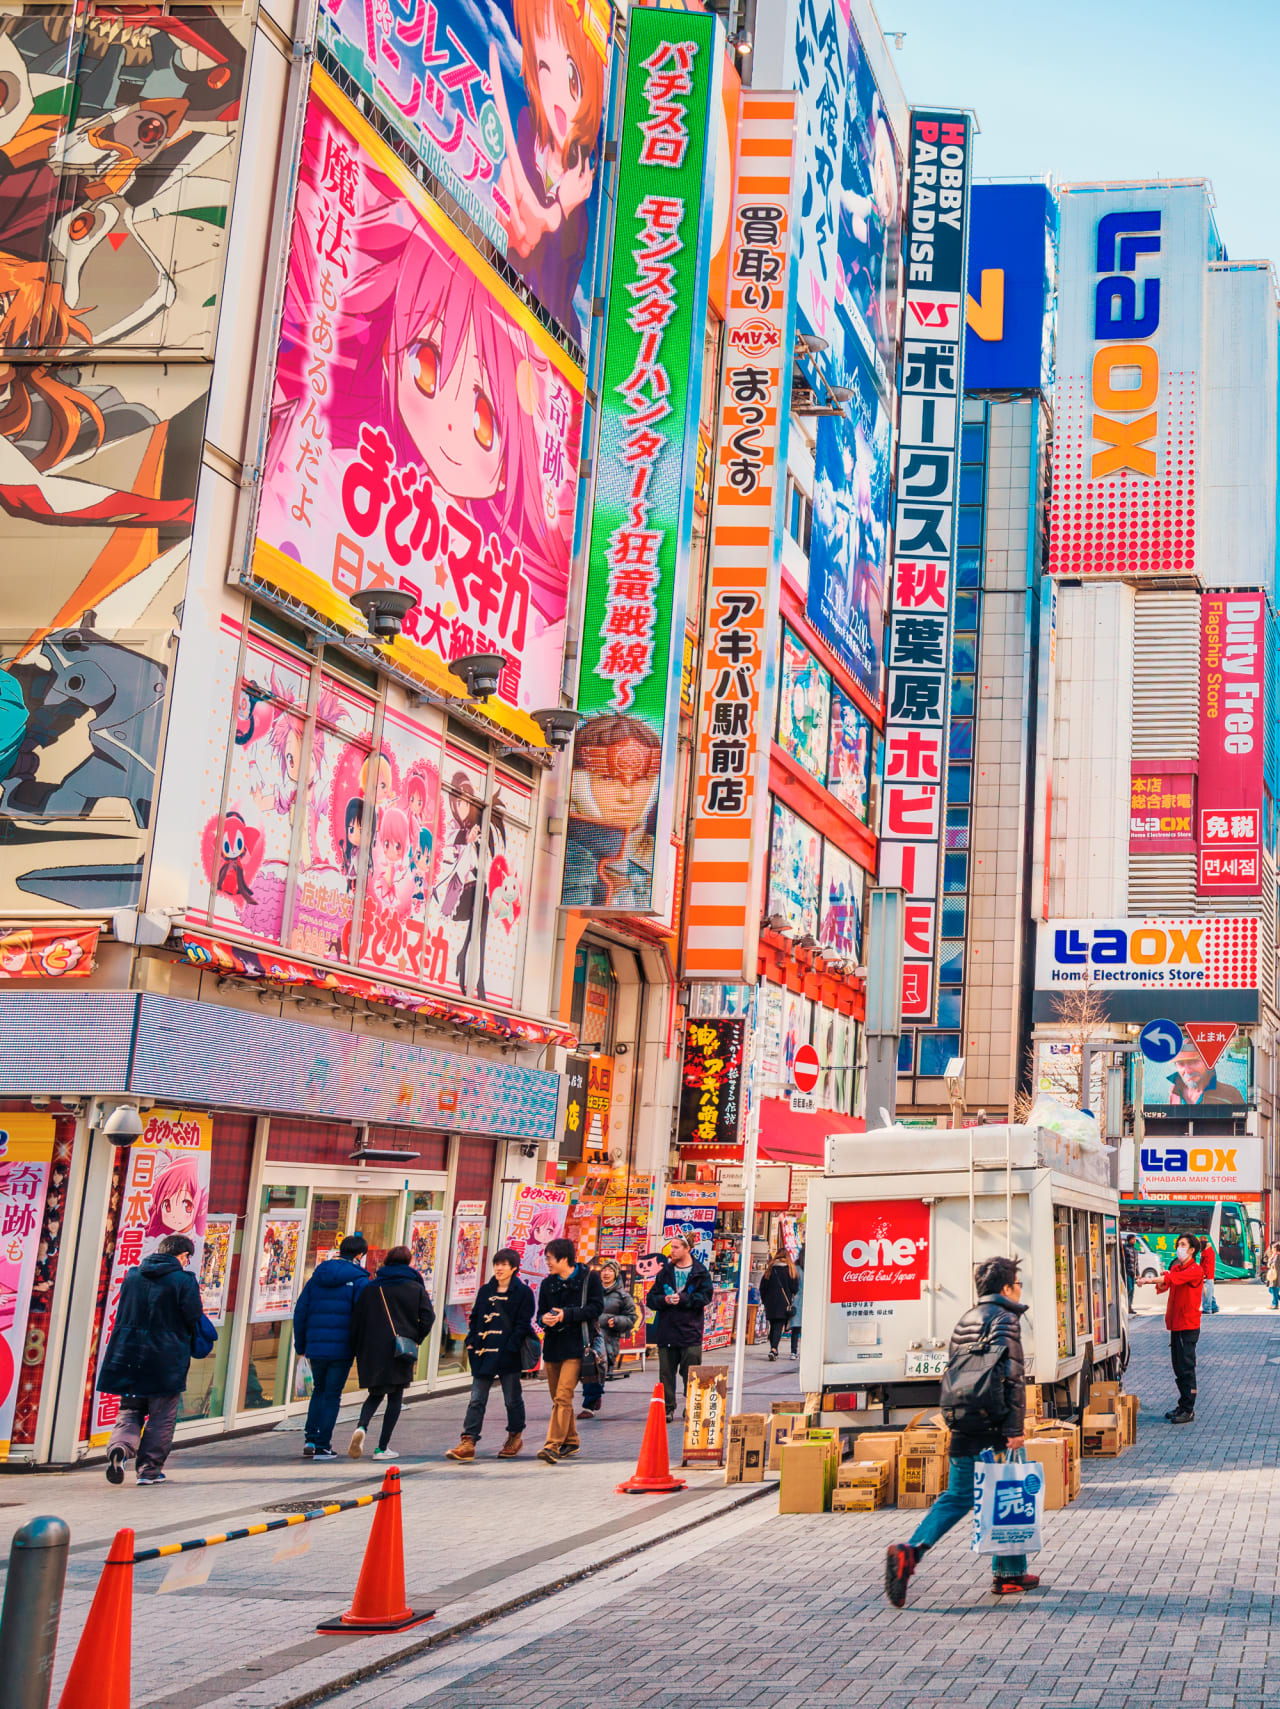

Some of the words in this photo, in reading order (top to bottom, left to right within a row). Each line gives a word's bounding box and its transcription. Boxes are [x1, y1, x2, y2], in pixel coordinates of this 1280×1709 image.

[641, 42, 698, 167] パチスロ
[909, 121, 939, 283] PARADISE
[939, 122, 964, 230] HOBBY
[739, 206, 785, 311] 買取り
[729, 367, 770, 495] まっくす
[1205, 602, 1223, 667] Flagship
[1223, 601, 1260, 675] Duty
[707, 594, 756, 812] アキバ駅前店
[1207, 674, 1222, 719] Store
[1224, 683, 1259, 754] Free
[1131, 794, 1191, 809] 総合家電
[1132, 777, 1162, 793] 本店
[1206, 816, 1254, 838] 免税
[1205, 858, 1255, 877] 면세점
[1052, 969, 1088, 981] Home
[1093, 969, 1164, 981] Electronics
[1169, 969, 1204, 981] Store
[1196, 1034, 1227, 1043] 止まれ
[588, 1066, 611, 1092] 入口
[1, 1165, 43, 1262] 奇跡も
[876, 1270, 893, 1282] East
[893, 1271, 916, 1284] Japan
[996, 1487, 1034, 1519] 売る
